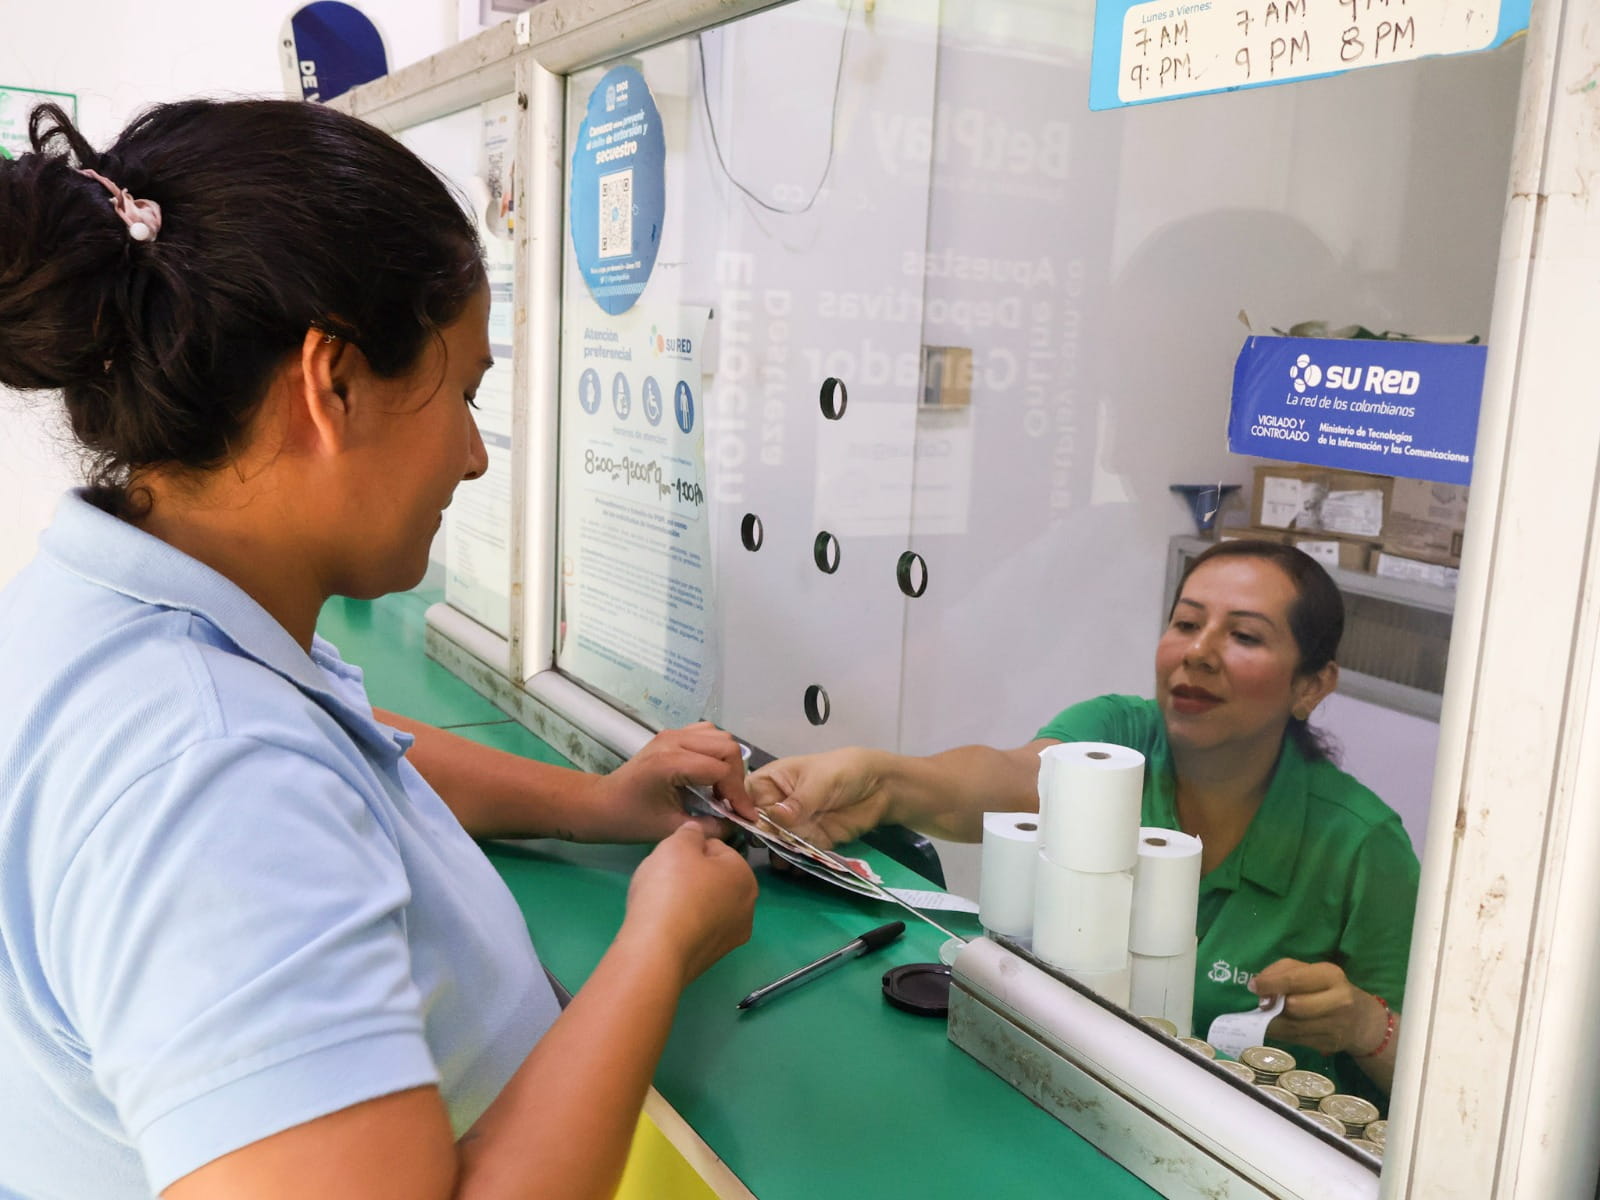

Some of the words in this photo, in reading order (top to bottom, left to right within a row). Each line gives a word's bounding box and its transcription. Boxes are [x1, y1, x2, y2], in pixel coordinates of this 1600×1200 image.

[1142, 12, 1167, 24] Lunes
[1168, 10, 1175, 18] a
[1340, 26, 1364, 62] 8
[1375, 16, 1415, 58] PM
[1235, 47, 1251, 79] 9
[1270, 30, 1310, 75] PM
[300, 60, 319, 89] DE
[595, 140, 638, 165] secuestro
[584, 328, 619, 342] Atención
[665, 338, 676, 352] SU
[676, 338, 692, 353] RED
[584, 345, 632, 361] preferencial
[1325, 365, 1362, 390] SU
[1286, 393, 1298, 405] La
[1300, 395, 1318, 407] red
[1318, 396, 1330, 409] de
[1332, 397, 1347, 411] los
[1350, 400, 1415, 418] colombianos
[1258, 414, 1297, 429] VIGILADO
[1299, 419, 1305, 430] Y
[1319, 422, 1354, 436] Ministerio
[1356, 426, 1366, 437] de
[1251, 425, 1310, 442] CONTROLADO
[1317, 434, 1328, 444] de
[1329, 435, 1336, 446] la
[1337, 437, 1382, 451] Información
[1383, 444, 1390, 455] y
[1391, 443, 1403, 455] las
[1404, 445, 1470, 463] Comunicaciones
